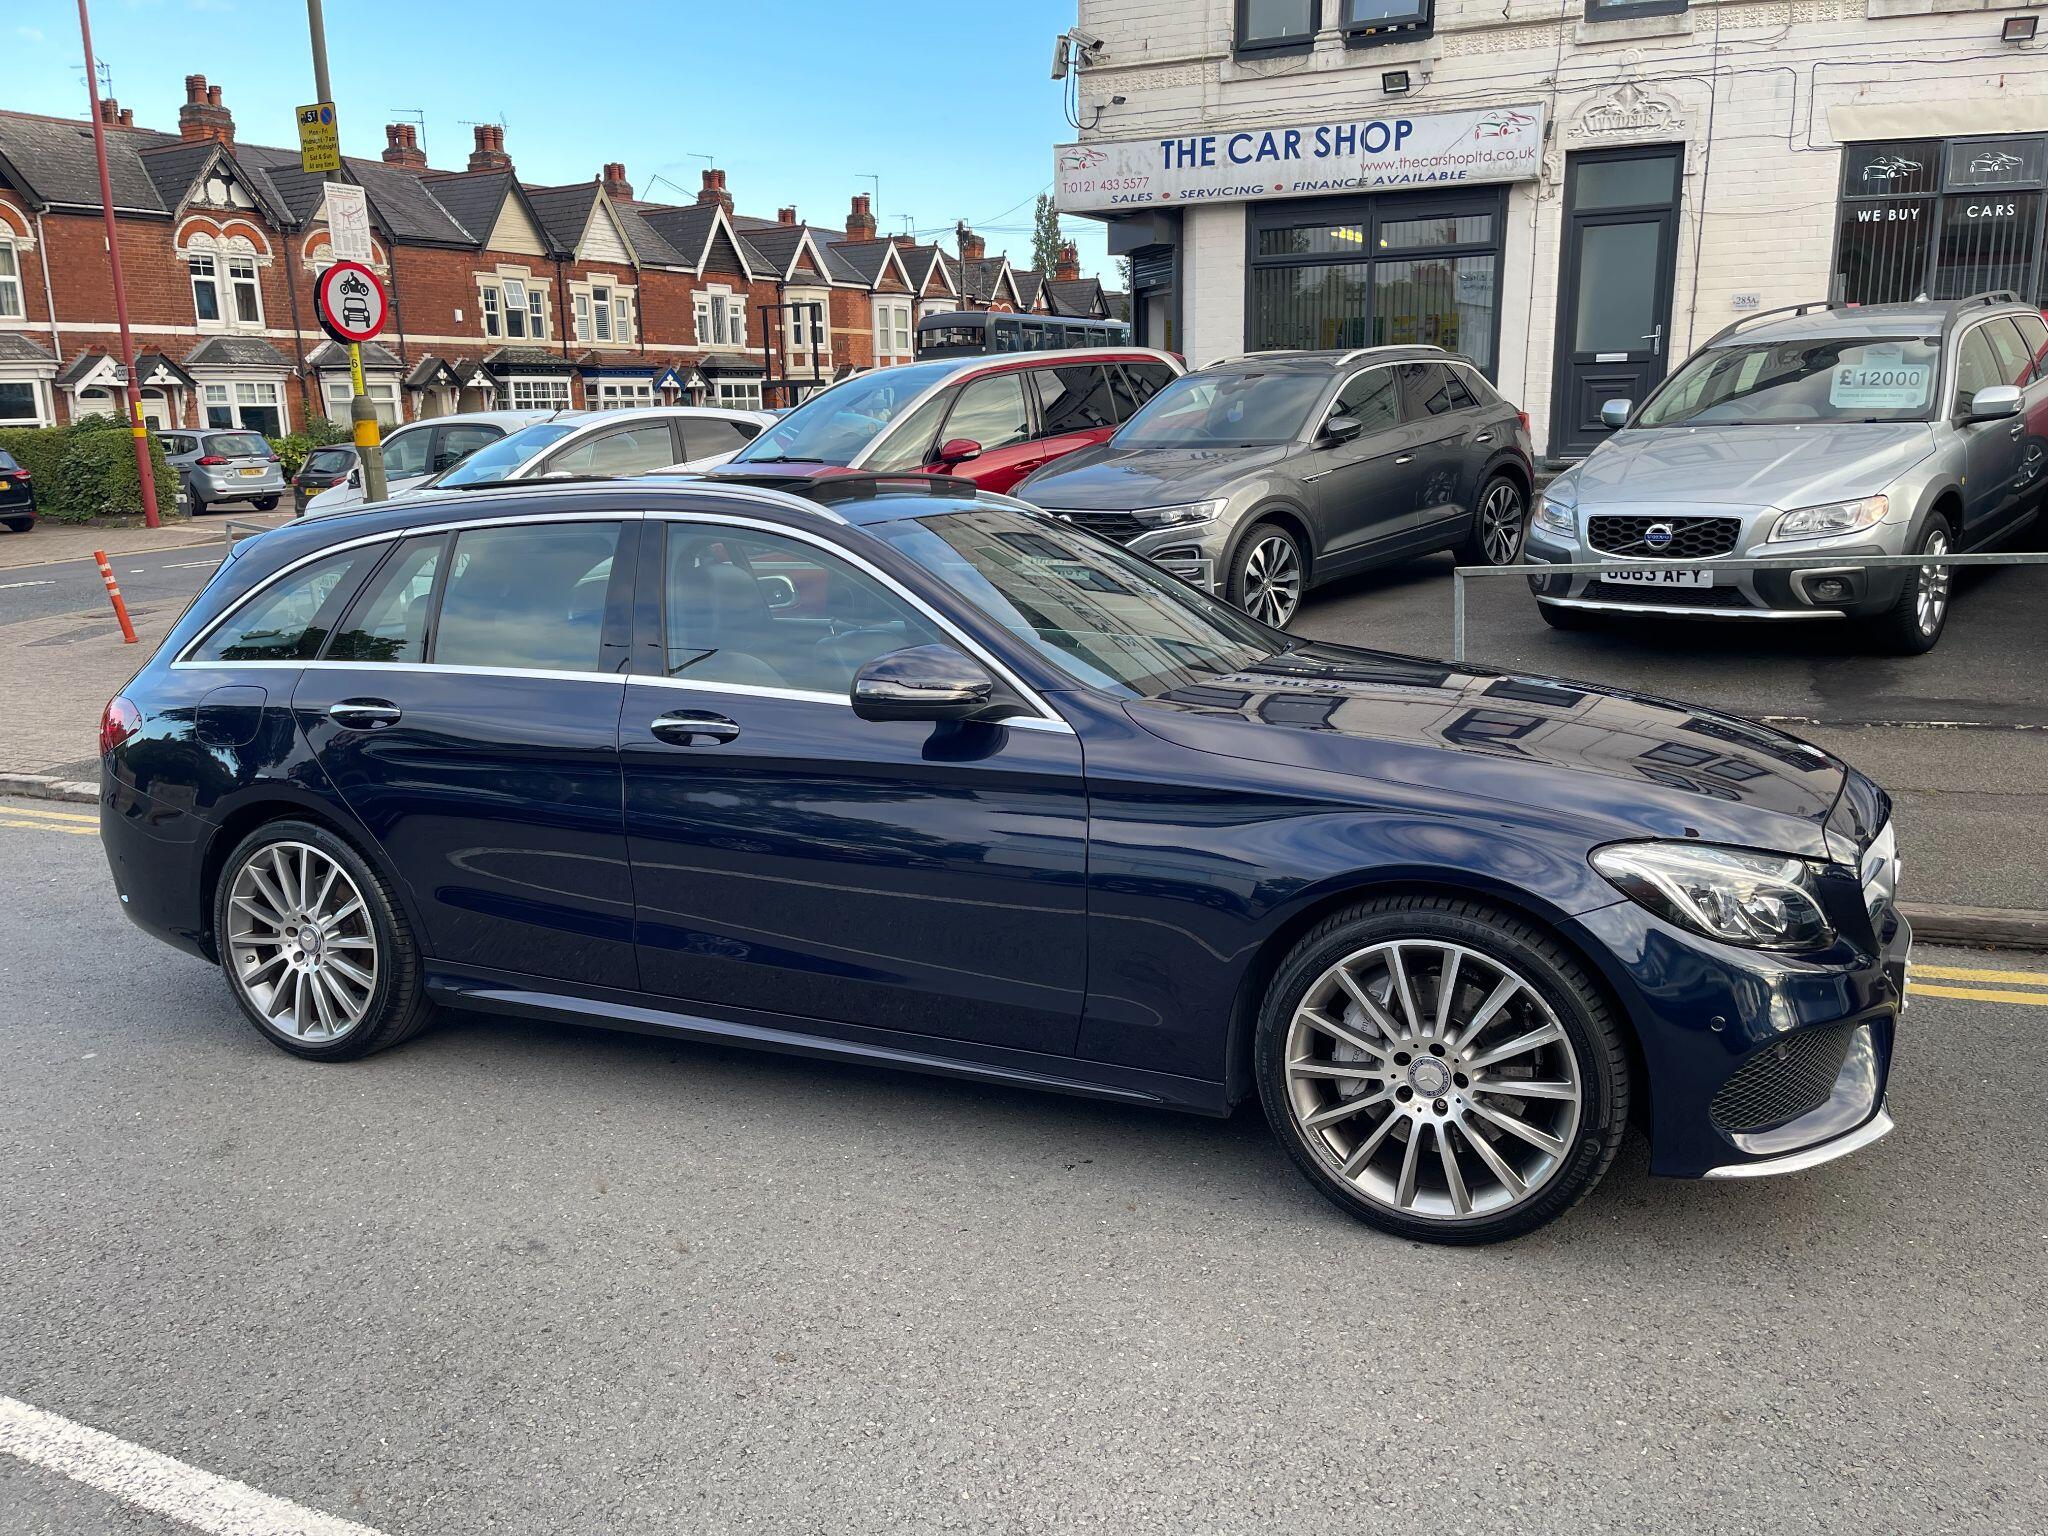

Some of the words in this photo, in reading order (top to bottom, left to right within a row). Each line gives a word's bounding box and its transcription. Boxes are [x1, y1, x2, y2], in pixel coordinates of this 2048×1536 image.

[1161, 136, 1216, 169] THE
[1228, 129, 1301, 164] CAR
[1314, 120, 1413, 158] SHOP
[1360, 146, 1535, 172] www.thecarshopltd.co.uk
[1100, 179, 1120, 191] 433
[1122, 177, 1150, 190] 5577
[1293, 177, 1368, 191] FINANCE
[1372, 170, 1468, 186] AVAILABLE
[1110, 192, 1153, 203] SALES
[1179, 184, 1264, 199] SERVICING
[1857, 209, 1881, 222] WE
[1888, 208, 1920, 221] BUY
[1966, 203, 2015, 218] CARS
